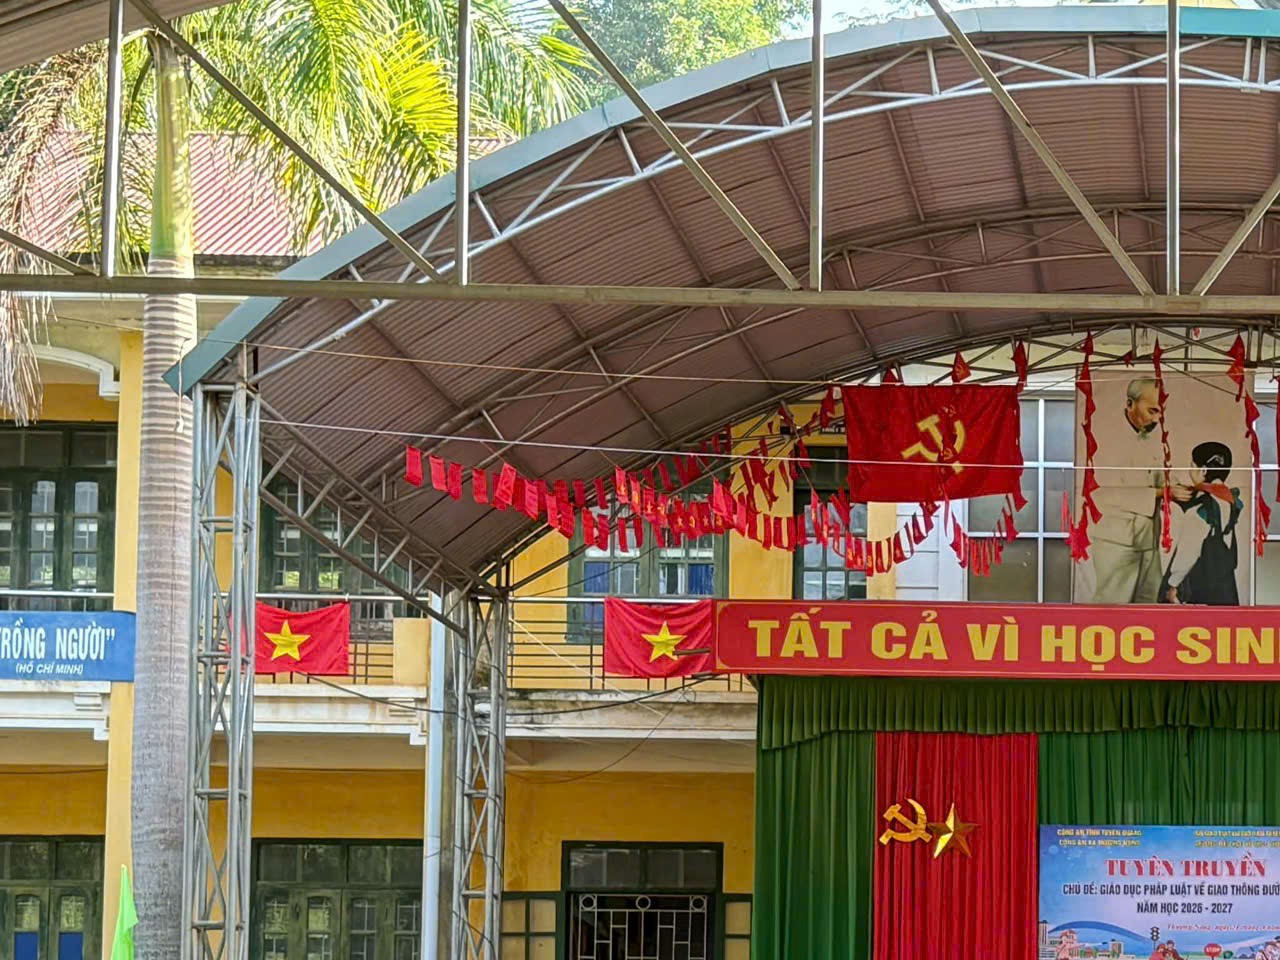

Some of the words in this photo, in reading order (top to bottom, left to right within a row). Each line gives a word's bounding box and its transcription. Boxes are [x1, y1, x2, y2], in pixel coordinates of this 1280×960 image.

[0, 617, 46, 659] RỒNG
[748, 607, 852, 658] TẤT
[871, 610, 949, 660] CẢ
[967, 616, 1019, 662] VÌ
[1041, 625, 1155, 671] HỌC
[36, 661, 56, 674] CHÍ
[1105, 855, 1175, 877] TUYÊN
[1180, 851, 1266, 877] TRUYỀN
[1063, 881, 1081, 895] CHỦ
[1100, 881, 1121, 895] GIÁO
[1123, 884, 1142, 898] DỤC
[1144, 882, 1168, 896] PHÁP
[1170, 882, 1192, 898] LUẬT
[1207, 884, 1229, 896] GIAO
[1230, 882, 1260, 896] THÔNG
[1137, 900, 1158, 913] NĂM
[1160, 902, 1179, 916] HỌC
[1211, 902, 1233, 914] 2027
